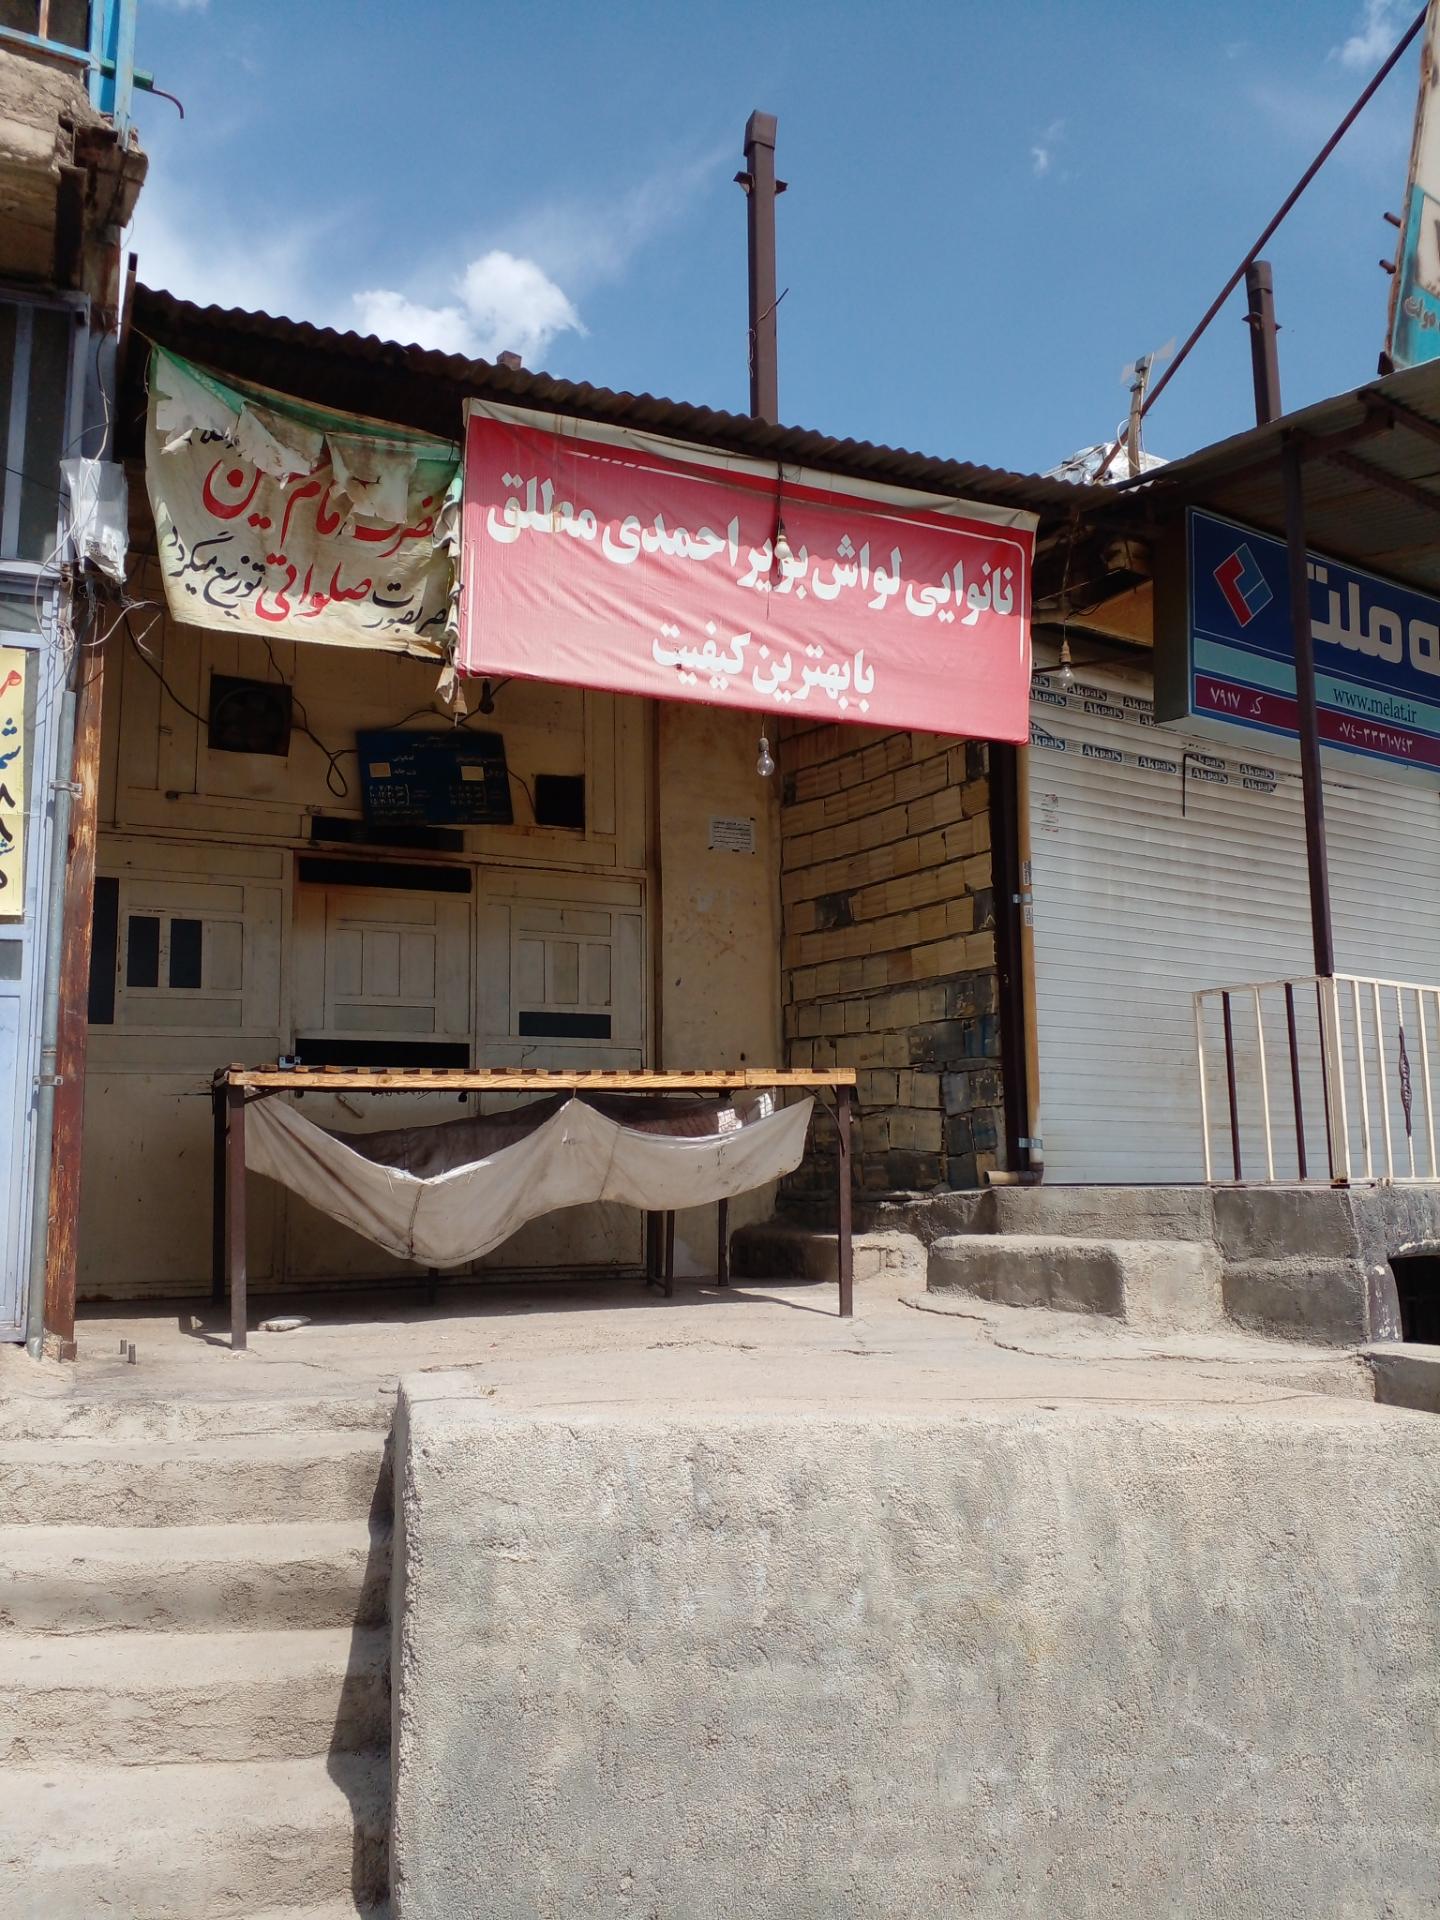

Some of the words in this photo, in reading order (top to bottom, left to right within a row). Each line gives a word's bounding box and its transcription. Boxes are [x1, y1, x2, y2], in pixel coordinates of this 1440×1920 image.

[486, 471, 598, 543] مطلق
[600, 513, 740, 566] احمدی
[202, 555, 266, 620] توزیع
[254, 552, 373, 622] صلواتی
[736, 537, 809, 600] بویر
[811, 533, 902, 610] لواش
[905, 558, 1015, 626] نانوایی
[650, 621, 752, 691] کیفیت
[751, 643, 852, 711] بهترین
[847, 648, 876, 713] با
[1249, 696, 1264, 715] کد
[1332, 687, 1417, 724] www.melat.ir
